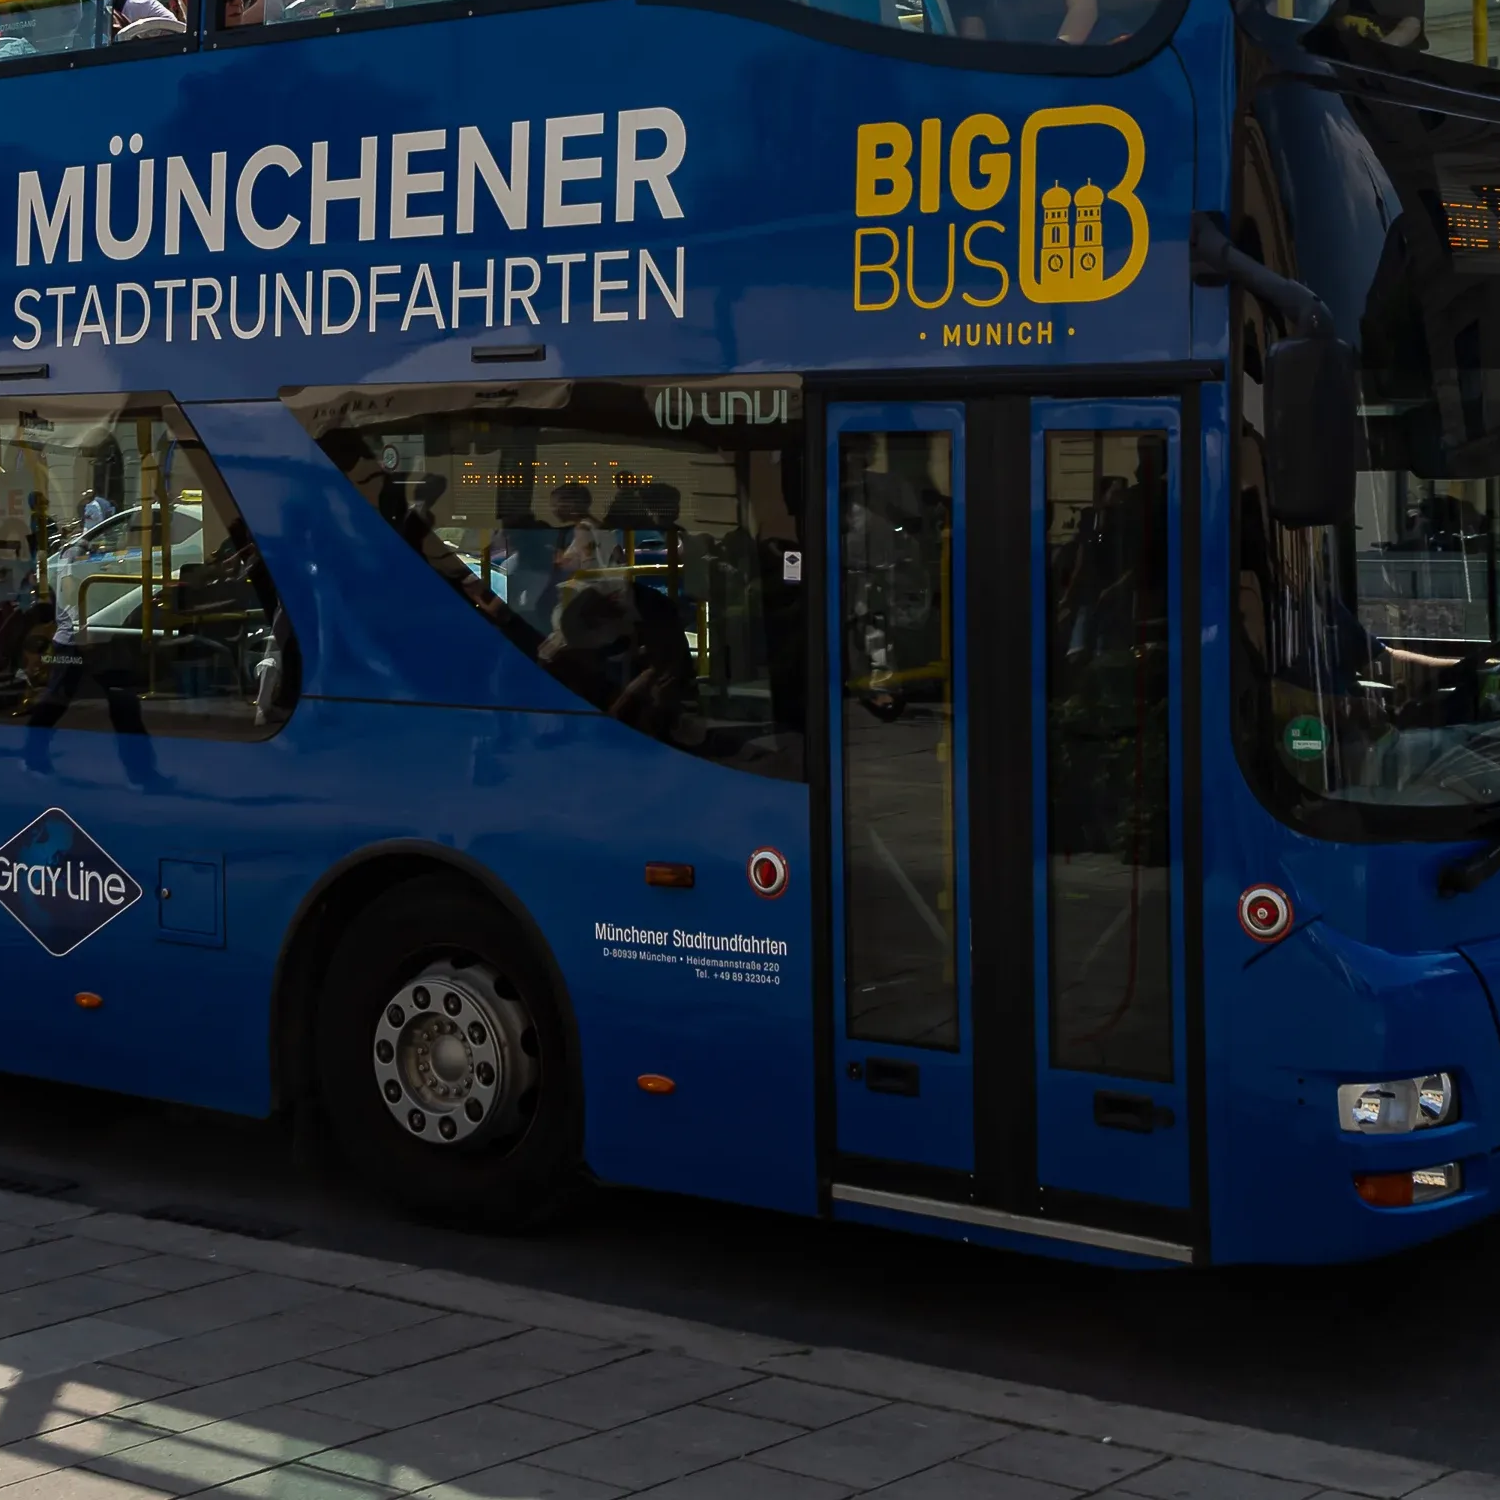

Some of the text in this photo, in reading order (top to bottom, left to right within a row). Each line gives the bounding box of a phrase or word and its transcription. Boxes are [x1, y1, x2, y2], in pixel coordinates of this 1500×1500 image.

[855, 112, 1012, 219] BIG
[14, 106, 687, 267] MÜNCHENER
[853, 219, 1010, 313] BUS
[12, 246, 687, 351] STADTRUNDFAHRTEN
[942, 320, 1054, 348] MUNICH
[40, 655, 84, 665] NOTAUSGANG
[66, 858, 127, 907] Line
[595, 922, 788, 956] Münchener Stadtrundfahrten
[603, 947, 780, 973] D-80939 München Heidemannstraße 220
[695, 968, 781, 986] Tel. +49 89 32304-0
